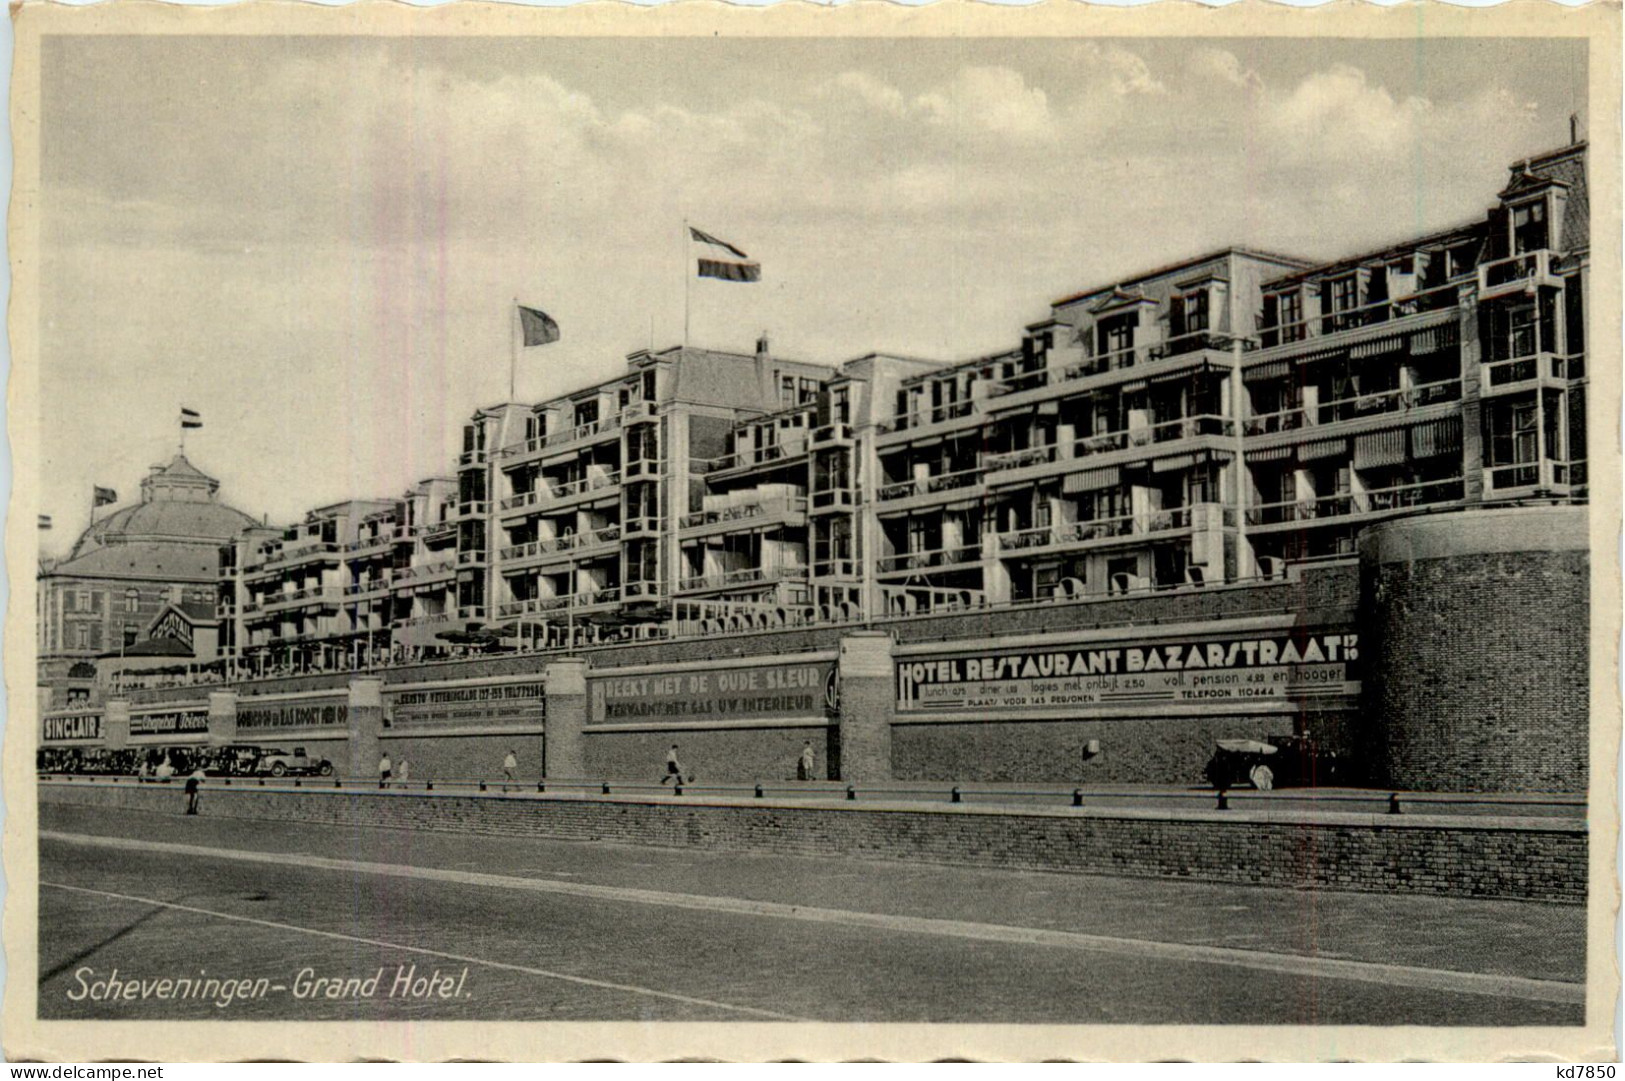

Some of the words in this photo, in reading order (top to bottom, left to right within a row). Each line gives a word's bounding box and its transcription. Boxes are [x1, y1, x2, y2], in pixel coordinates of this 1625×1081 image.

[654, 677, 682, 696] MET
[690, 675, 708, 693] DE
[718, 671, 758, 692] OUDE
[766, 668, 820, 689] SLEUR
[900, 660, 961, 710] HOTEL
[966, 650, 1121, 681] RESTAURANT
[1126, 636, 1342, 672] BAZARSTRAAT
[980, 681, 1001, 694] diner
[1031, 678, 1059, 695] logies
[1064, 677, 1081, 691] met
[1086, 675, 1118, 692] ontbijt
[1193, 673, 1239, 688] pension
[1273, 672, 1288, 682] en
[1295, 665, 1342, 682] hooger
[718, 698, 739, 713] UW
[743, 696, 814, 712] INTERIEUR
[1003, 697, 1027, 706] VOOR
[1051, 694, 1095, 704] PERSONEN
[1181, 688, 1231, 698] TELEFOON
[45, 716, 97, 739] SINCLAIR
